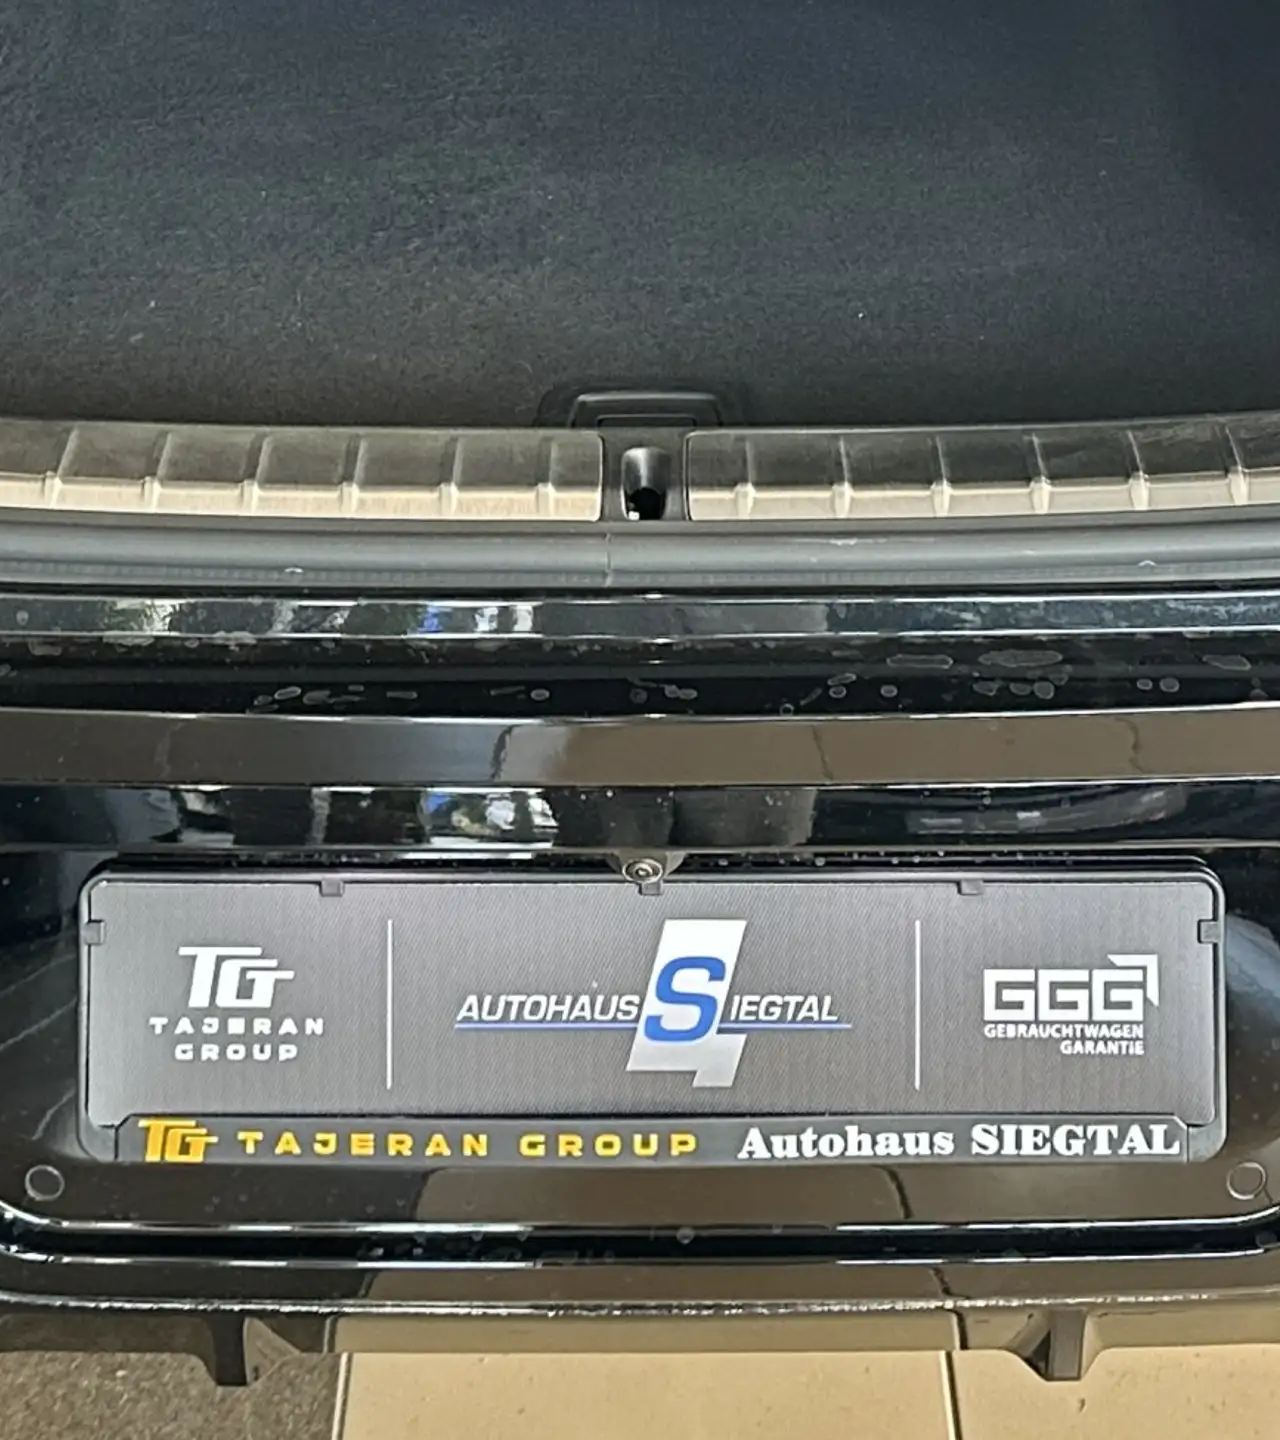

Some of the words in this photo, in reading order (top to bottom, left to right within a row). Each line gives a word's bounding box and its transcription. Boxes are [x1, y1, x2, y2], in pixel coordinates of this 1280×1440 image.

[983, 968, 1144, 1021] GGG
[456, 994, 639, 1021] AUTOHAUS
[148, 1016, 324, 1036] TAJERAN
[983, 1023, 1144, 1039] GEBRAUCHTWAGEN
[174, 1043, 298, 1061] GROUP
[1059, 1039, 1145, 1056] GARANTIE
[237, 1131, 488, 1156] TAJERAN
[519, 1133, 698, 1157] GROUP
[737, 1124, 955, 1160] Autohaus
[970, 1123, 1181, 1156] SIEGTAL
